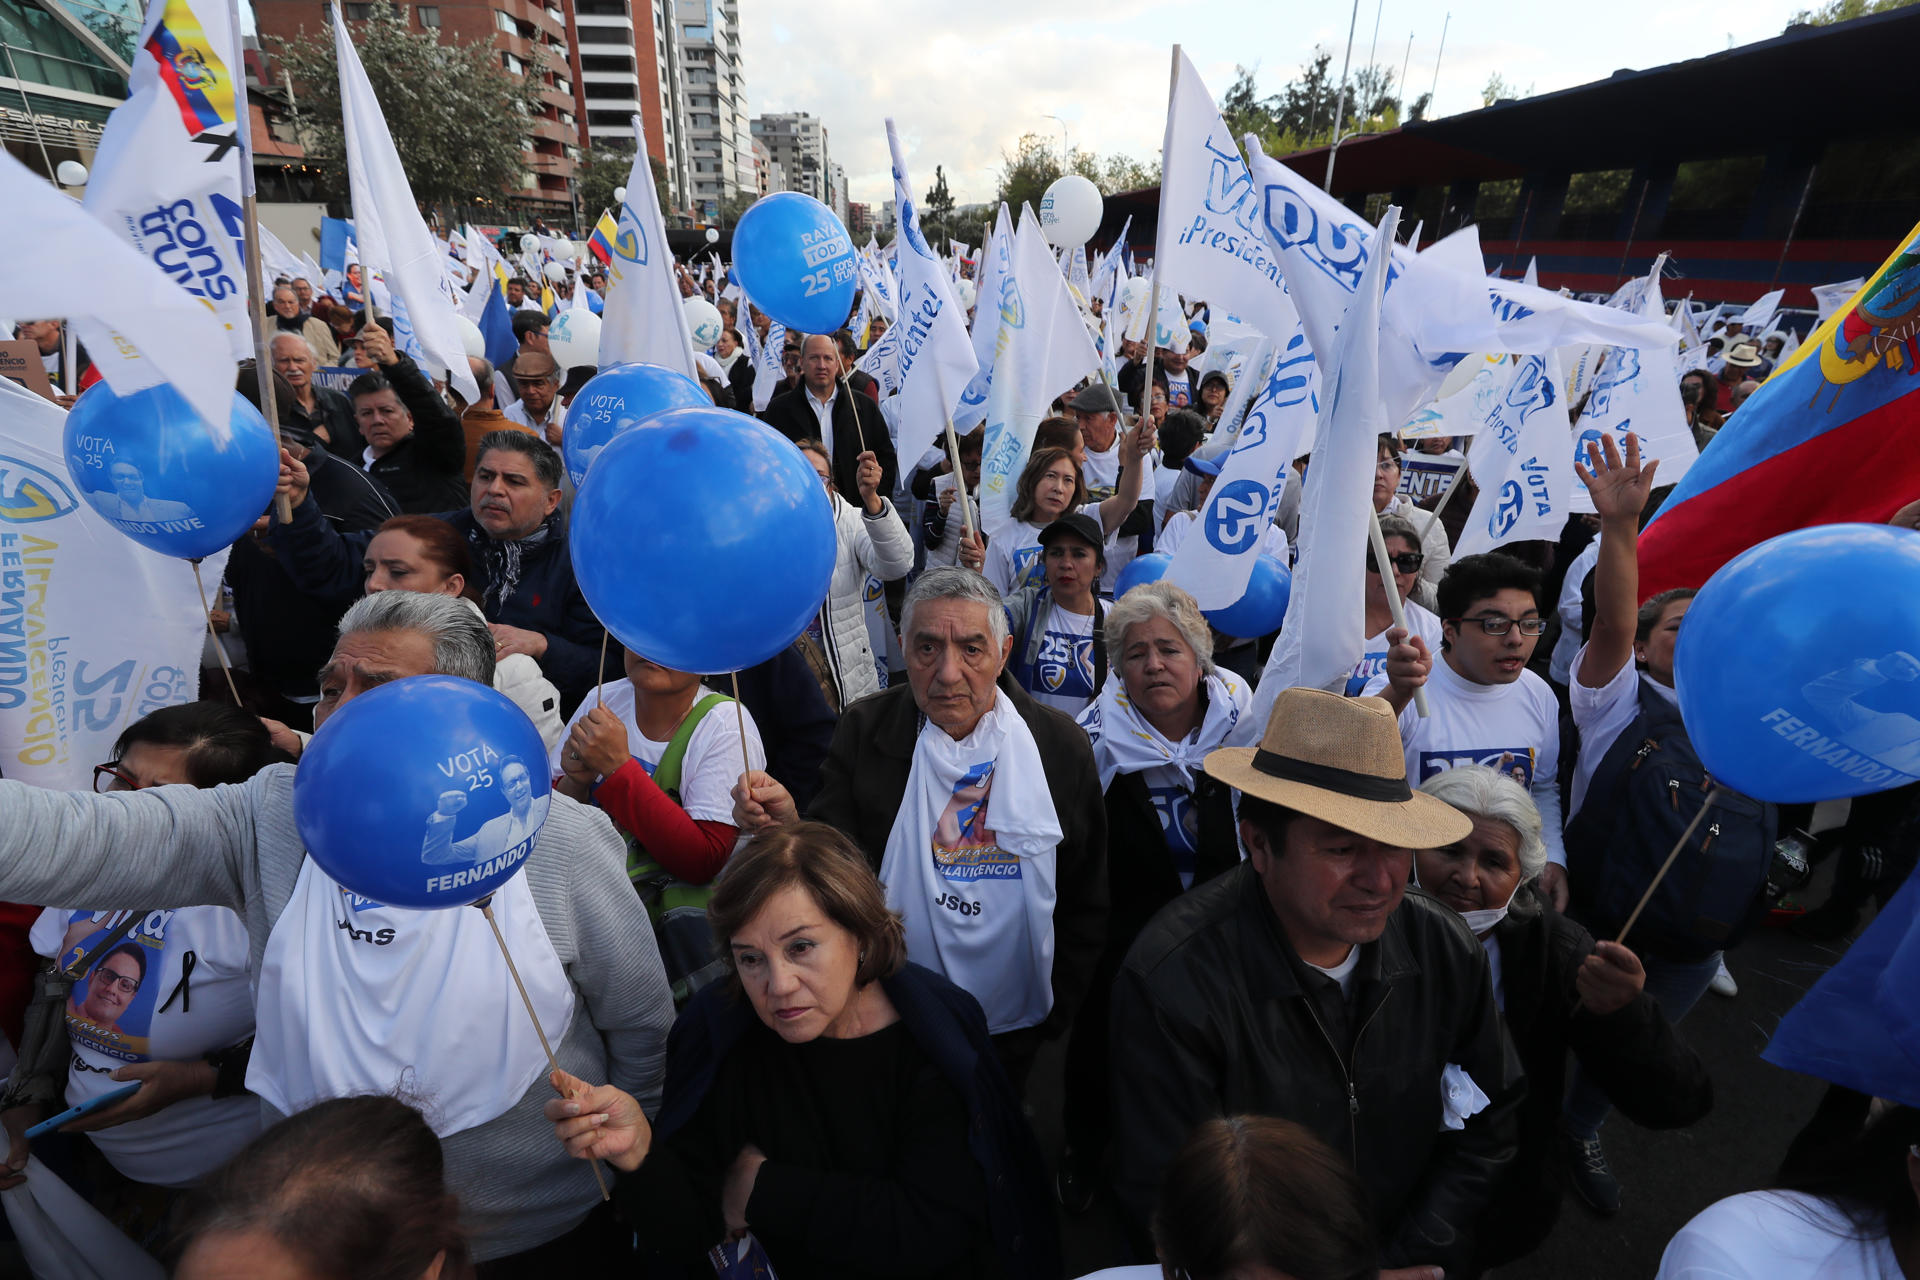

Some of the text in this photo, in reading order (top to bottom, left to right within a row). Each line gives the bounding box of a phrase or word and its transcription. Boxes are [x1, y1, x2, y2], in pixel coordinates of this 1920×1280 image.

[801, 224, 840, 246] RAYA
[807, 239, 847, 262] TODO
[801, 267, 832, 297] 25
[590, 394, 625, 411] VOTA
[594, 409, 612, 424] 25
[76, 434, 115, 455] VOTA
[85, 453, 104, 469] 25
[155, 516, 206, 534] VIVE
[1216, 491, 1264, 545] 25
[1038, 636, 1070, 664] 25
[1759, 707, 1893, 784] FERNANDO
[436, 743, 499, 778] VOTA
[465, 768, 494, 792] 25
[426, 842, 527, 893] FERNANDO
